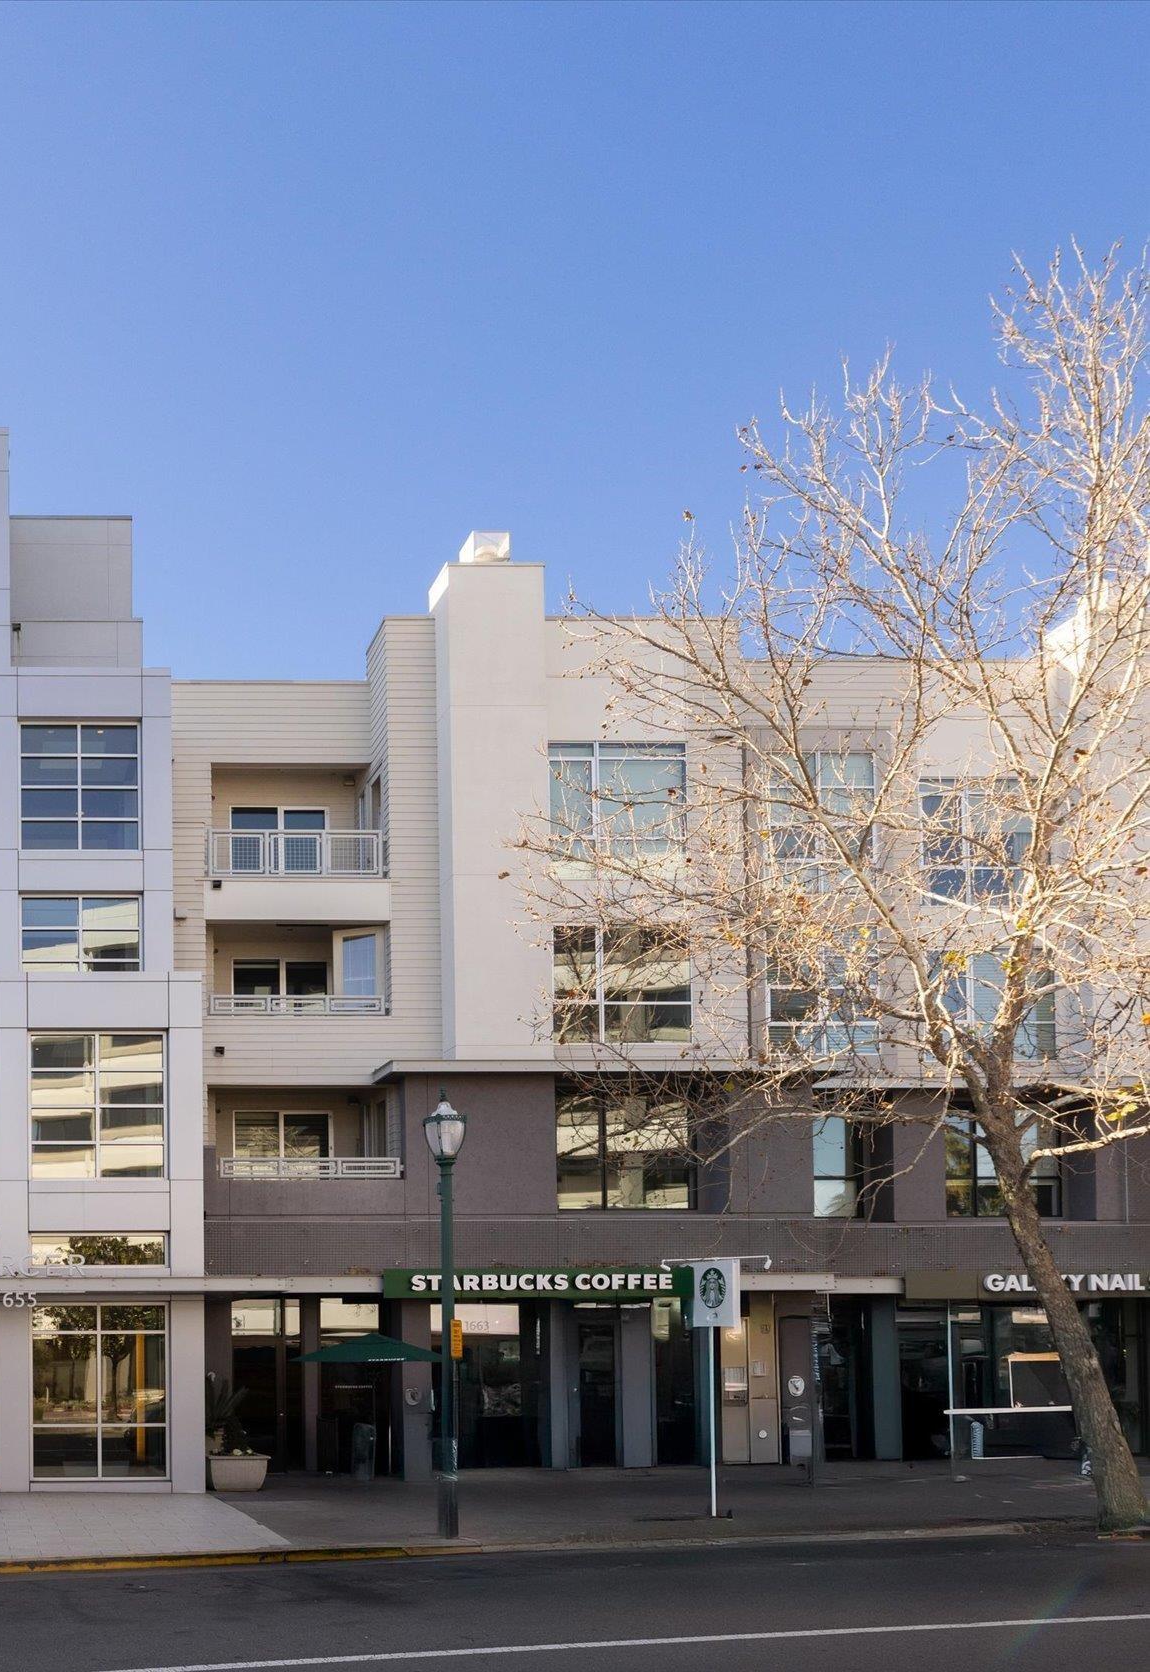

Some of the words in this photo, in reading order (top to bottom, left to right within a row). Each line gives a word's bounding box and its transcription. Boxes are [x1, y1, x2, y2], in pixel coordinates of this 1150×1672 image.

[575, 1273, 673, 1290] COFFEE
[984, 1274, 1085, 1291] GALY
[1088, 1274, 1145, 1291] NAIL
[465, 1321, 489, 1331] 1663
